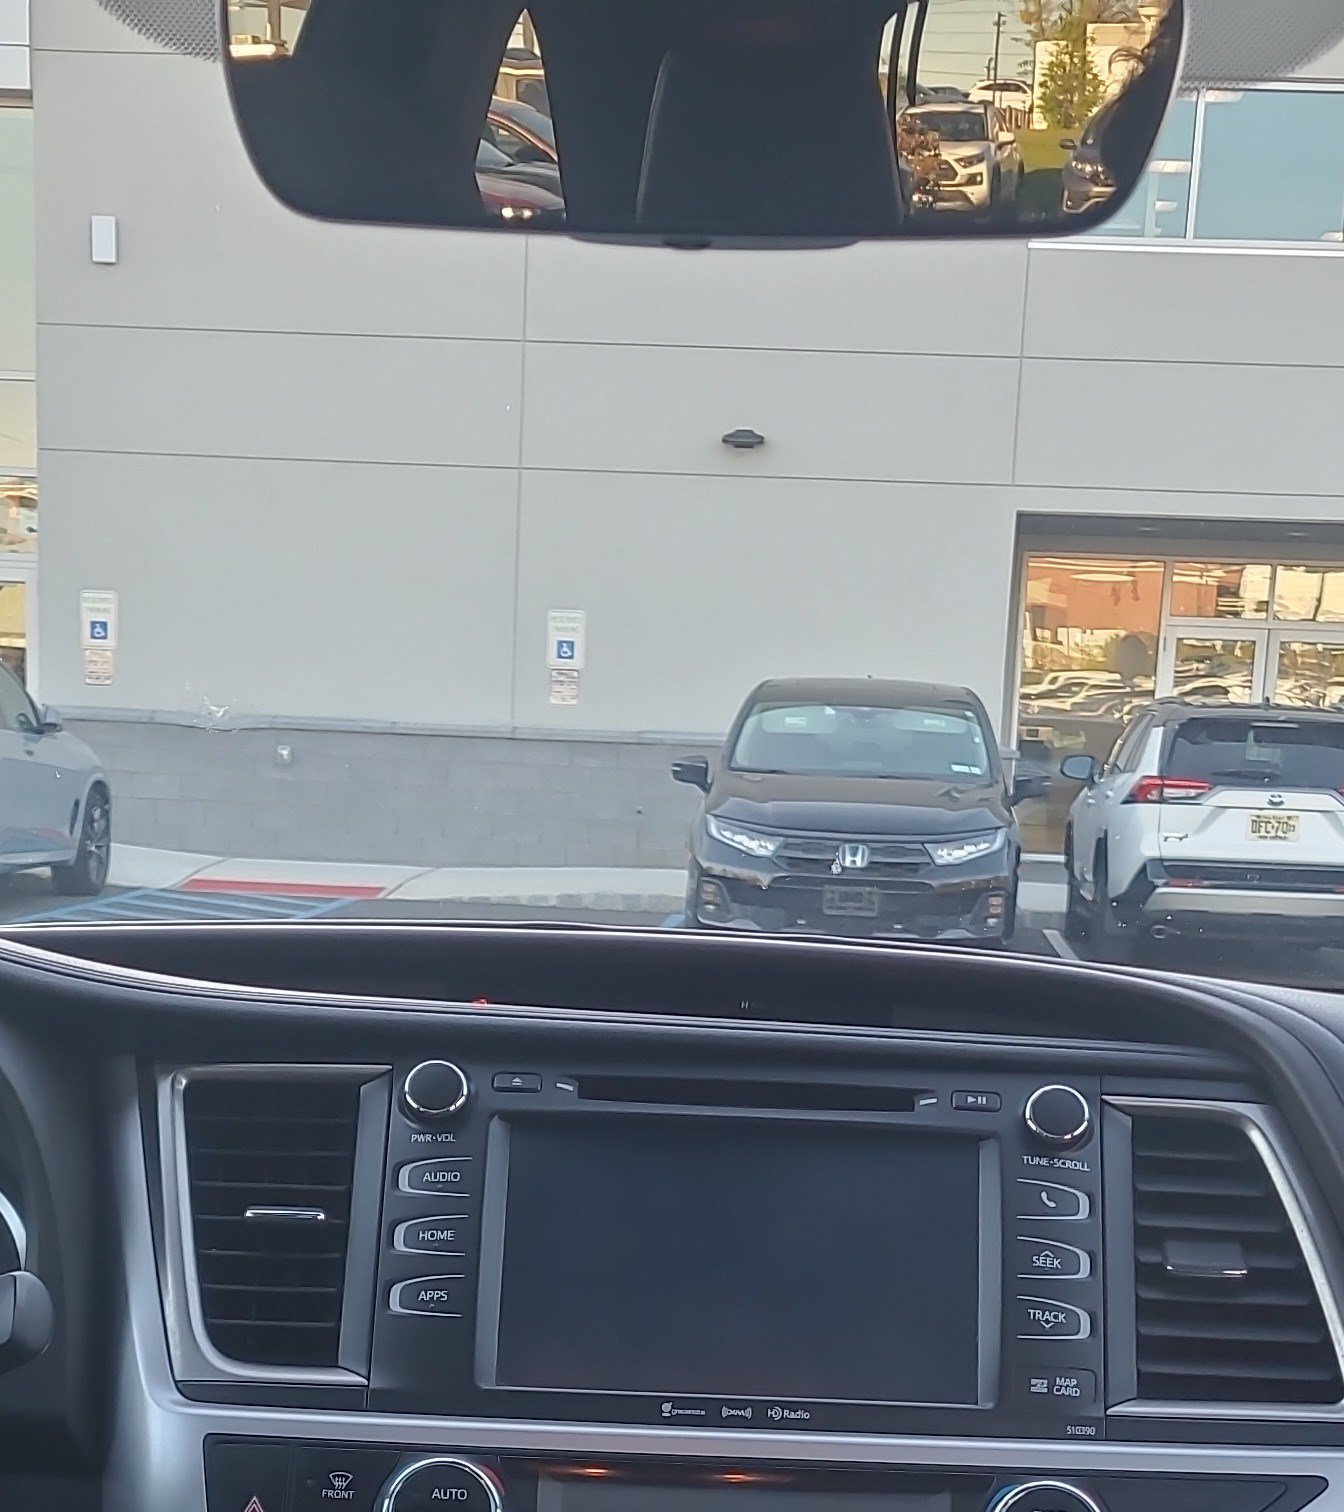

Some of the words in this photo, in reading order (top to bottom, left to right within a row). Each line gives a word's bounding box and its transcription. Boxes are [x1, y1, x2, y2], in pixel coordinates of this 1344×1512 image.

[422, 1171, 461, 1183] AUDIO
[418, 1230, 456, 1242] HOME
[1032, 1255, 1062, 1270] SEEK
[417, 1290, 448, 1301] APPS
[1027, 1308, 1067, 1324] TRACK
[1055, 1376, 1078, 1387] MAP
[1053, 1385, 1081, 1397] CARD
[783, 1408, 811, 1420] Radio
[321, 1488, 356, 1500] FRONT
[431, 1488, 468, 1501] AUTO
